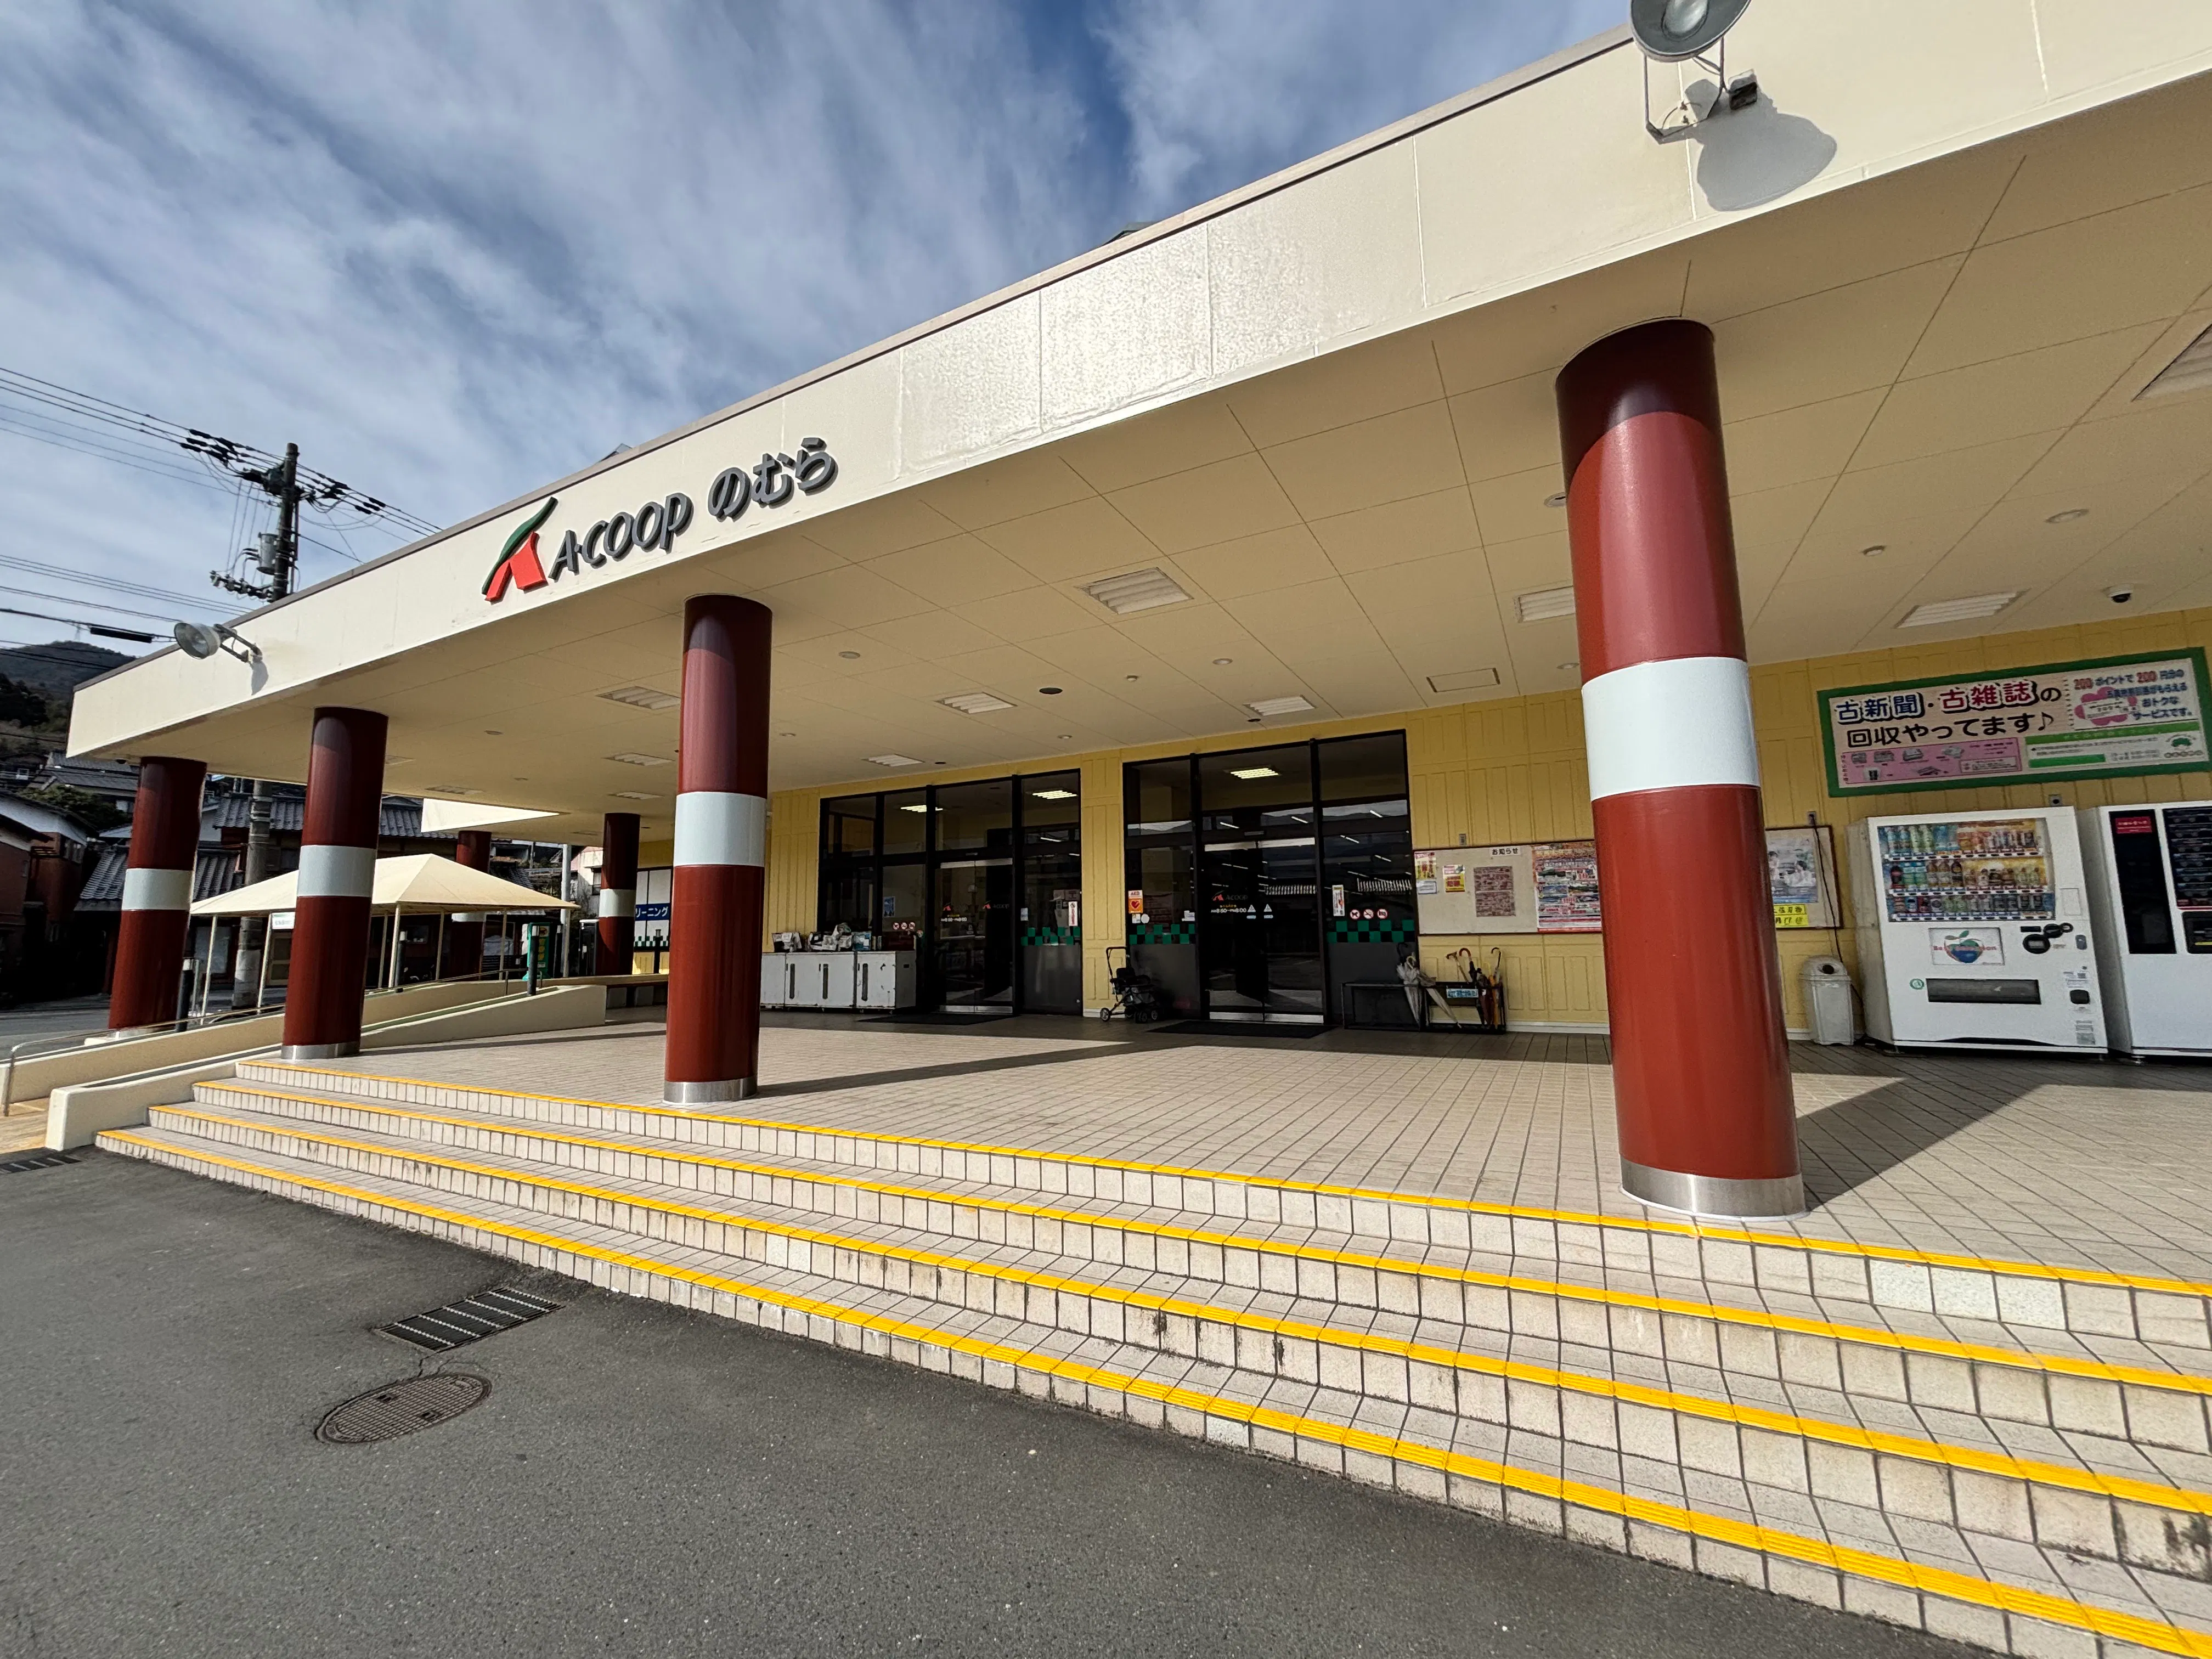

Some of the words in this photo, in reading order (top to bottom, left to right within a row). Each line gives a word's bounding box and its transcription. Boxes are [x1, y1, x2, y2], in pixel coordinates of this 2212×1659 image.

[707, 437, 839, 522] のむら
[1835, 680, 2062, 722] 古新聞・古雑誌の
[1492, 847, 1518, 855] お知らせ
